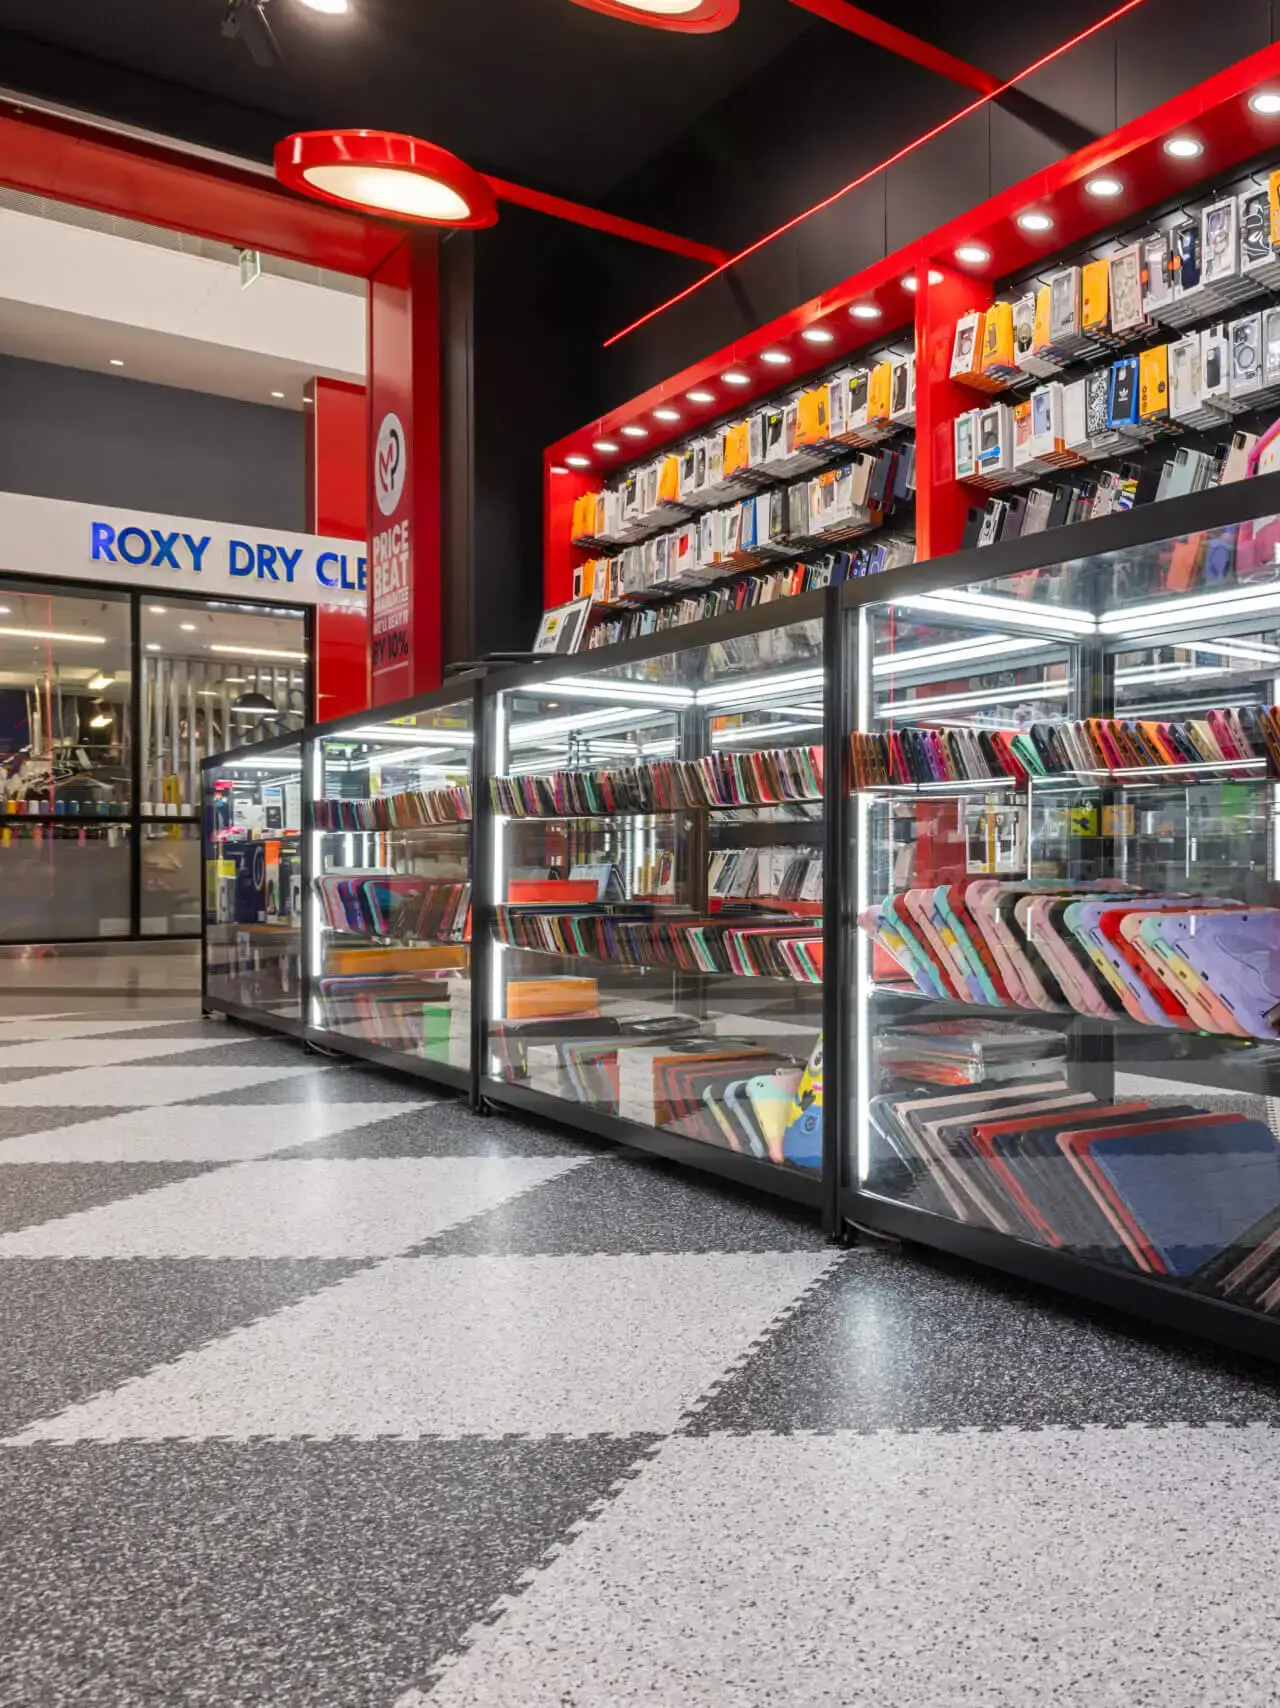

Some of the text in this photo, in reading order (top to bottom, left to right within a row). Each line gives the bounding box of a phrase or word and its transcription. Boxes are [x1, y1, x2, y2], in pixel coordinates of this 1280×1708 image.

[91, 521, 212, 573] ROXY
[228, 539, 303, 583] DRY
[373, 520, 409, 566] PRICE
[373, 549, 409, 599] BEAT
[387, 630, 409, 660] 10%
